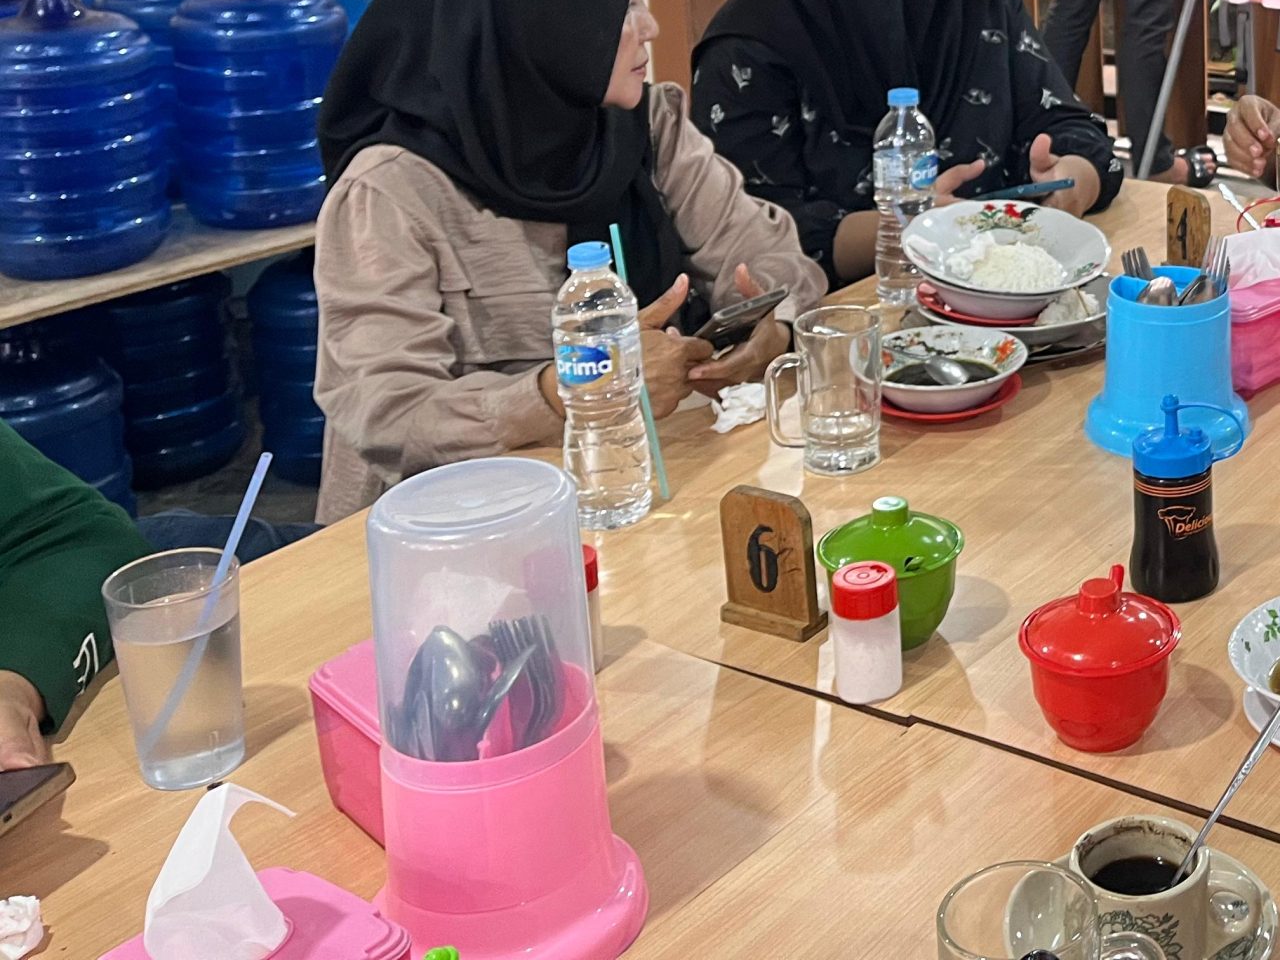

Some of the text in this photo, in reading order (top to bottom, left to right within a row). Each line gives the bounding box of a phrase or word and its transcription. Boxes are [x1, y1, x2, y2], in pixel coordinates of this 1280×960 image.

[1176, 207, 1188, 260] 4
[557, 357, 613, 376] prima
[747, 524, 779, 593] 6
